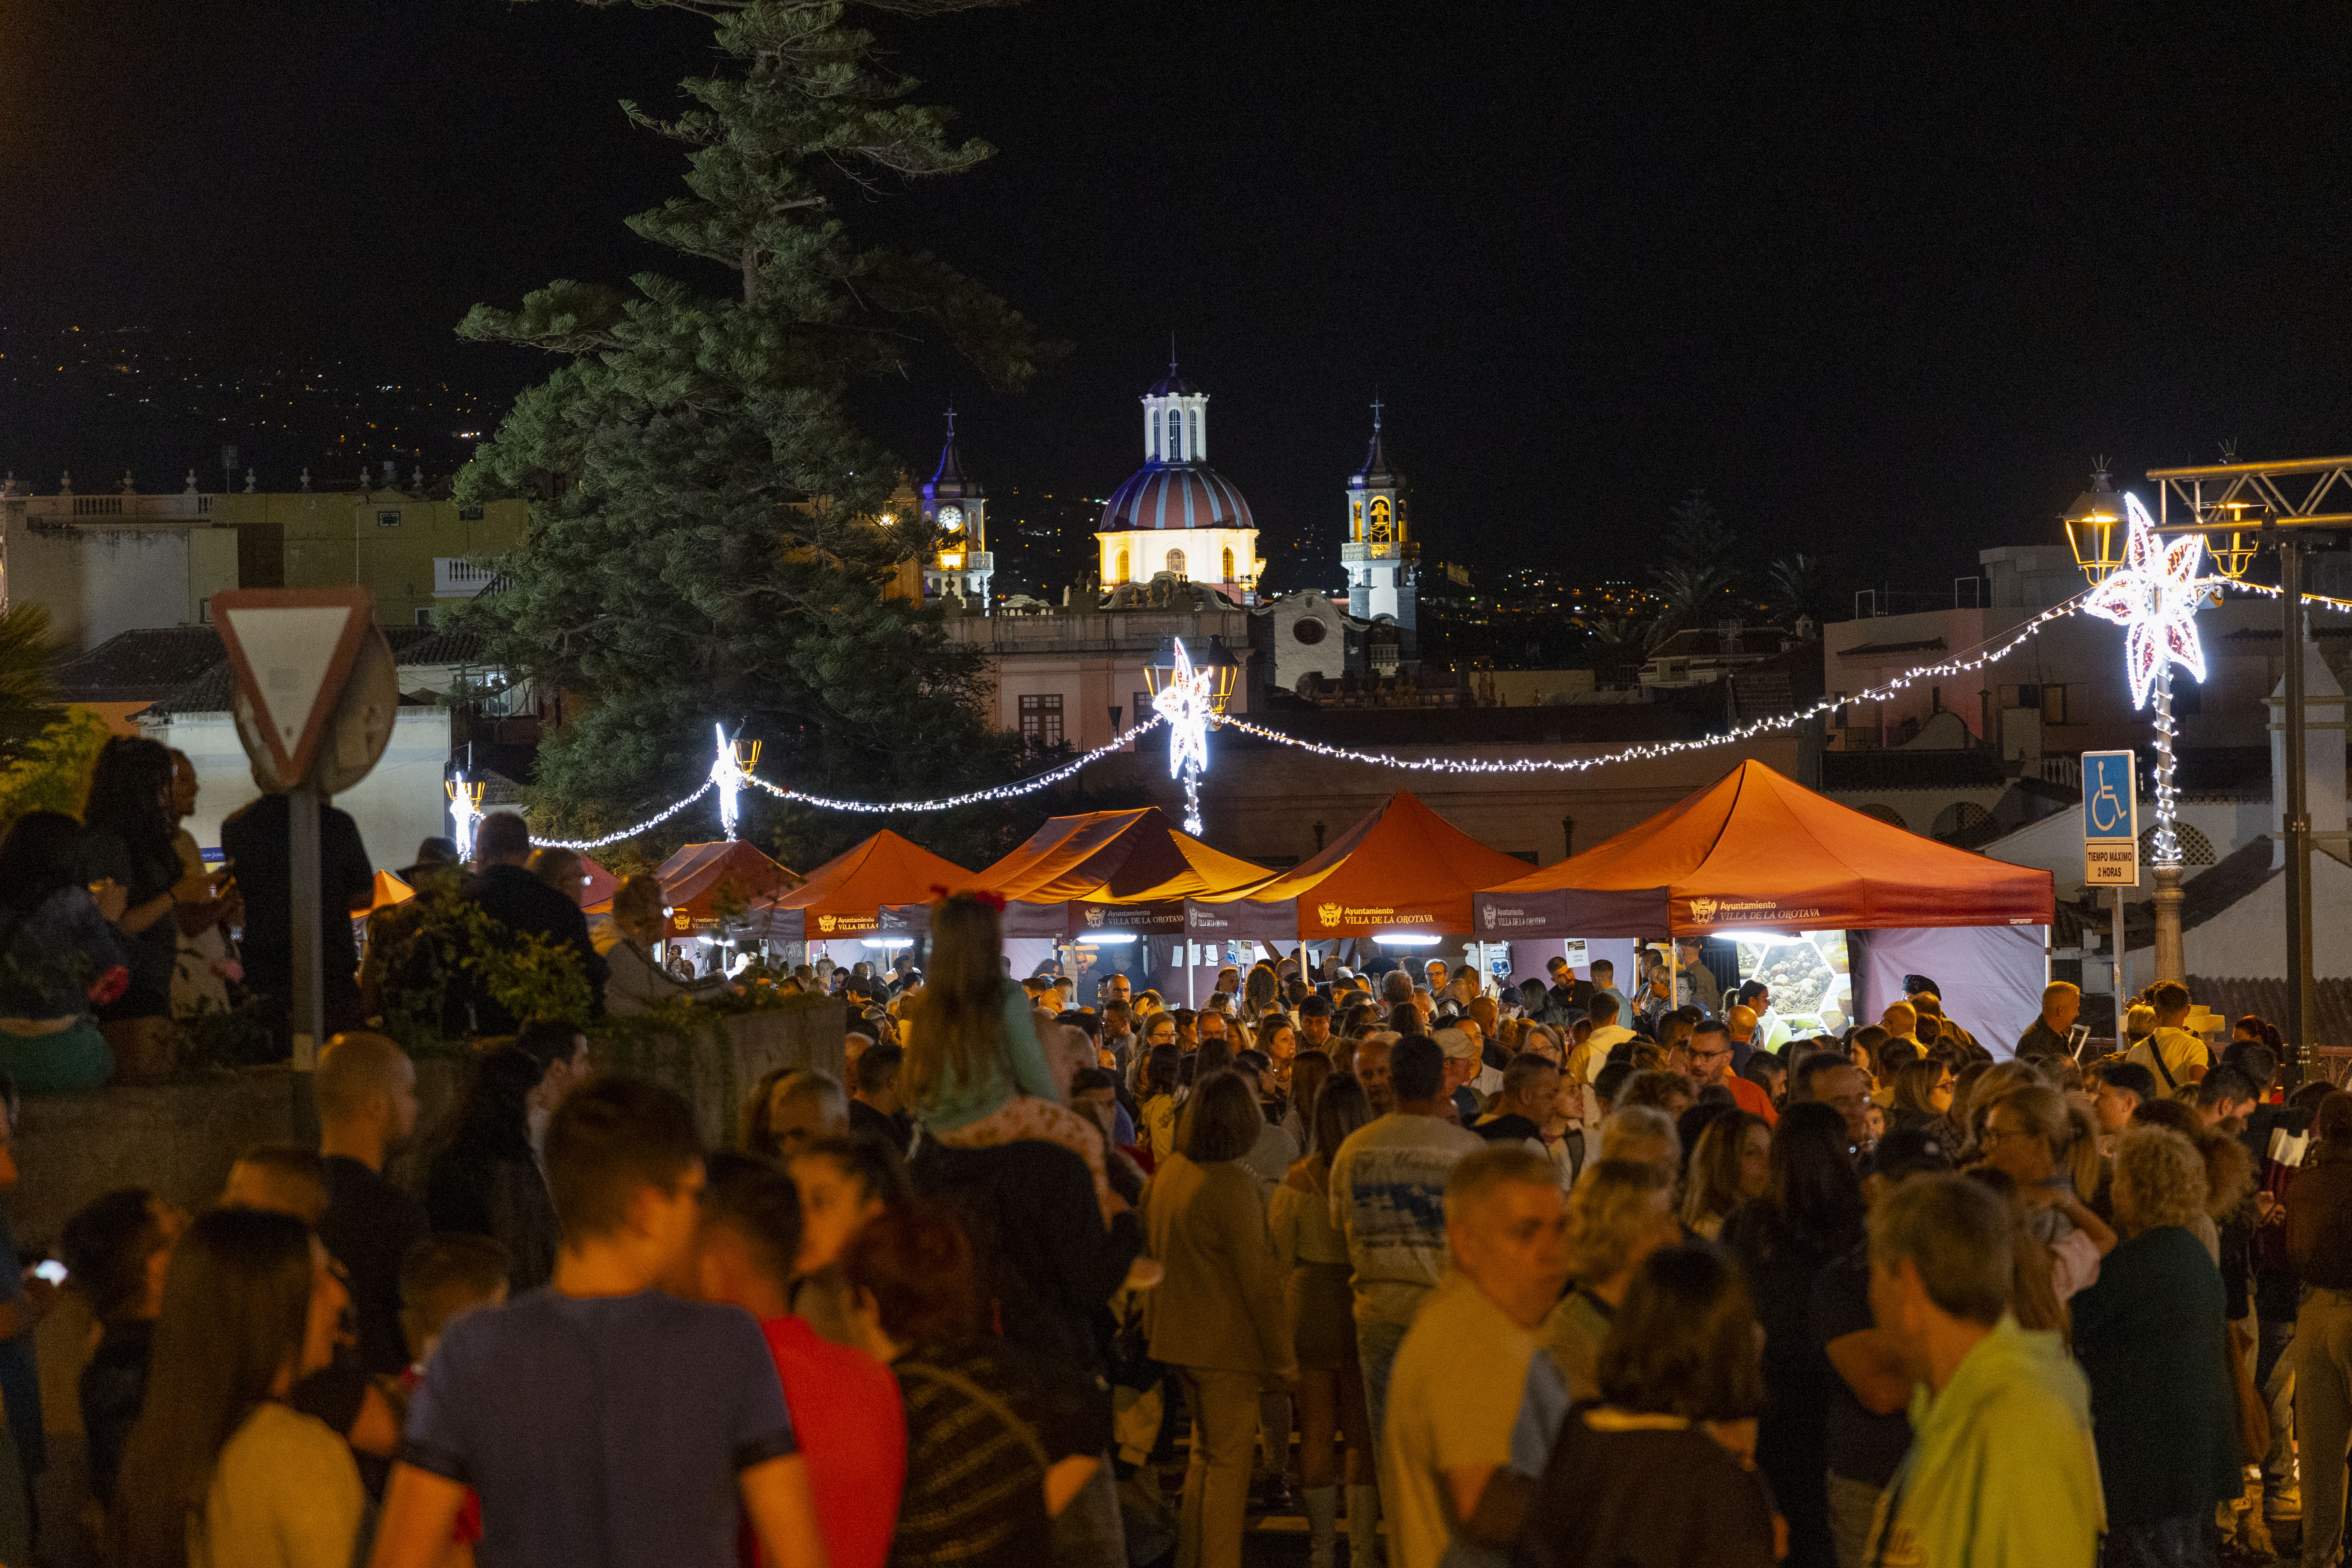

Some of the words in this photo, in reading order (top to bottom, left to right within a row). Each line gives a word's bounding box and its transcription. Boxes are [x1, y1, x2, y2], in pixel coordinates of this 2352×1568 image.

[2088, 852, 2108, 862] TIEMPO
[2110, 849, 2132, 862] MÁXIMO
[2098, 867, 2101, 877] 2
[2103, 867, 2122, 877] HORAS
[1720, 900, 1776, 911] Ayuntamiento
[1108, 910, 1150, 918] Ayuntamiento
[1344, 907, 1393, 916] Ayuntamiento
[1498, 907, 1524, 916] Ayuntamiento
[1720, 912, 1747, 920] VILLA
[1764, 911, 1775, 919] LA
[1778, 909, 1820, 919] OROTAVA
[1152, 915, 1184, 924] OROTAVA
[1344, 916, 1369, 924] VILLA
[1383, 916, 1395, 924] LA
[1396, 914, 1434, 924] OROTAVA
[1498, 918, 1512, 926] VILLA
